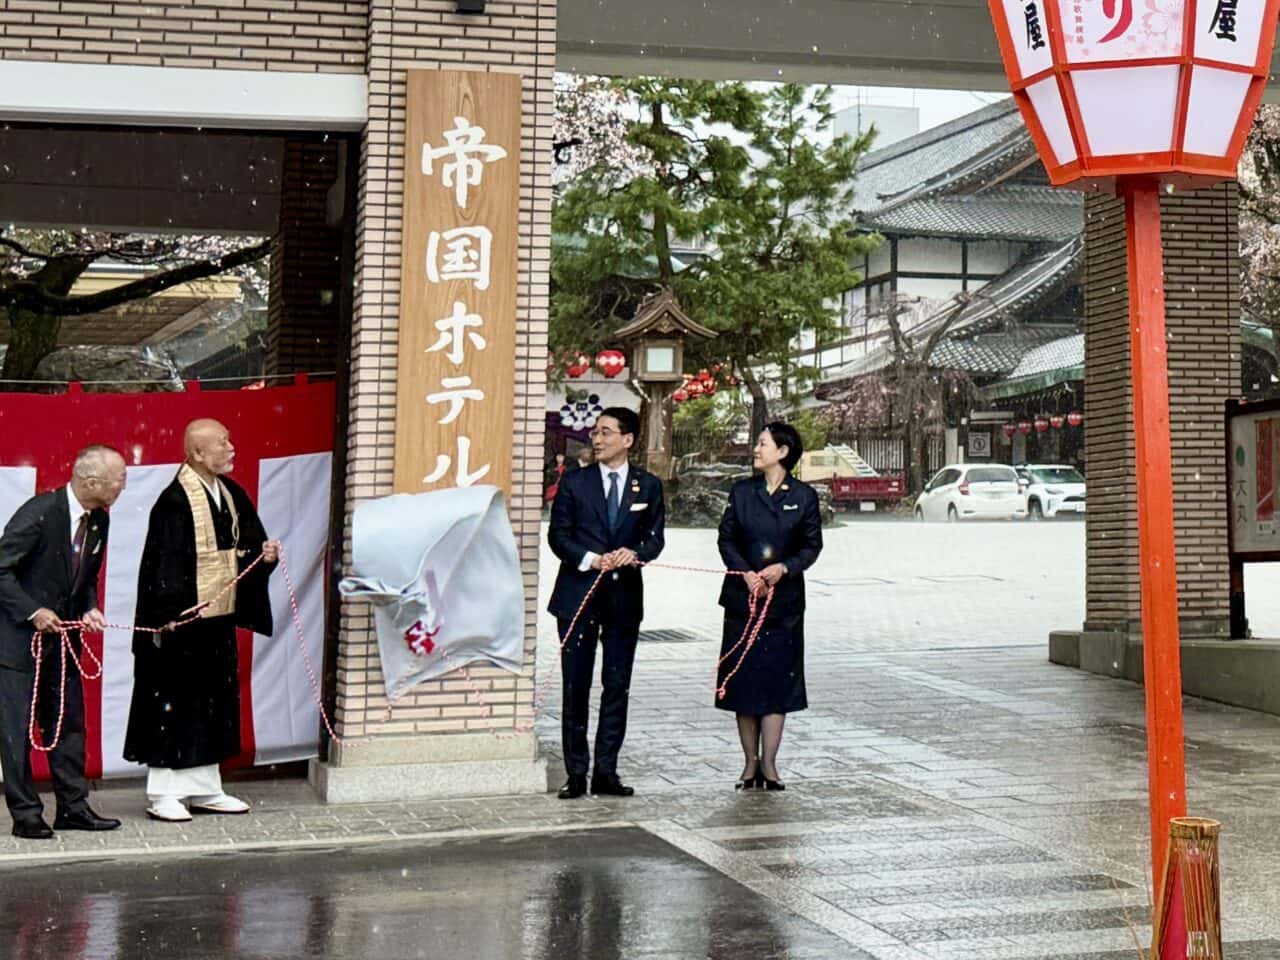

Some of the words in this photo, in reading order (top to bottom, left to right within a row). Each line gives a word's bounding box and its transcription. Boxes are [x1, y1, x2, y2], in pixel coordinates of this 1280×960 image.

[421, 116, 508, 487] 帝国ホテル
